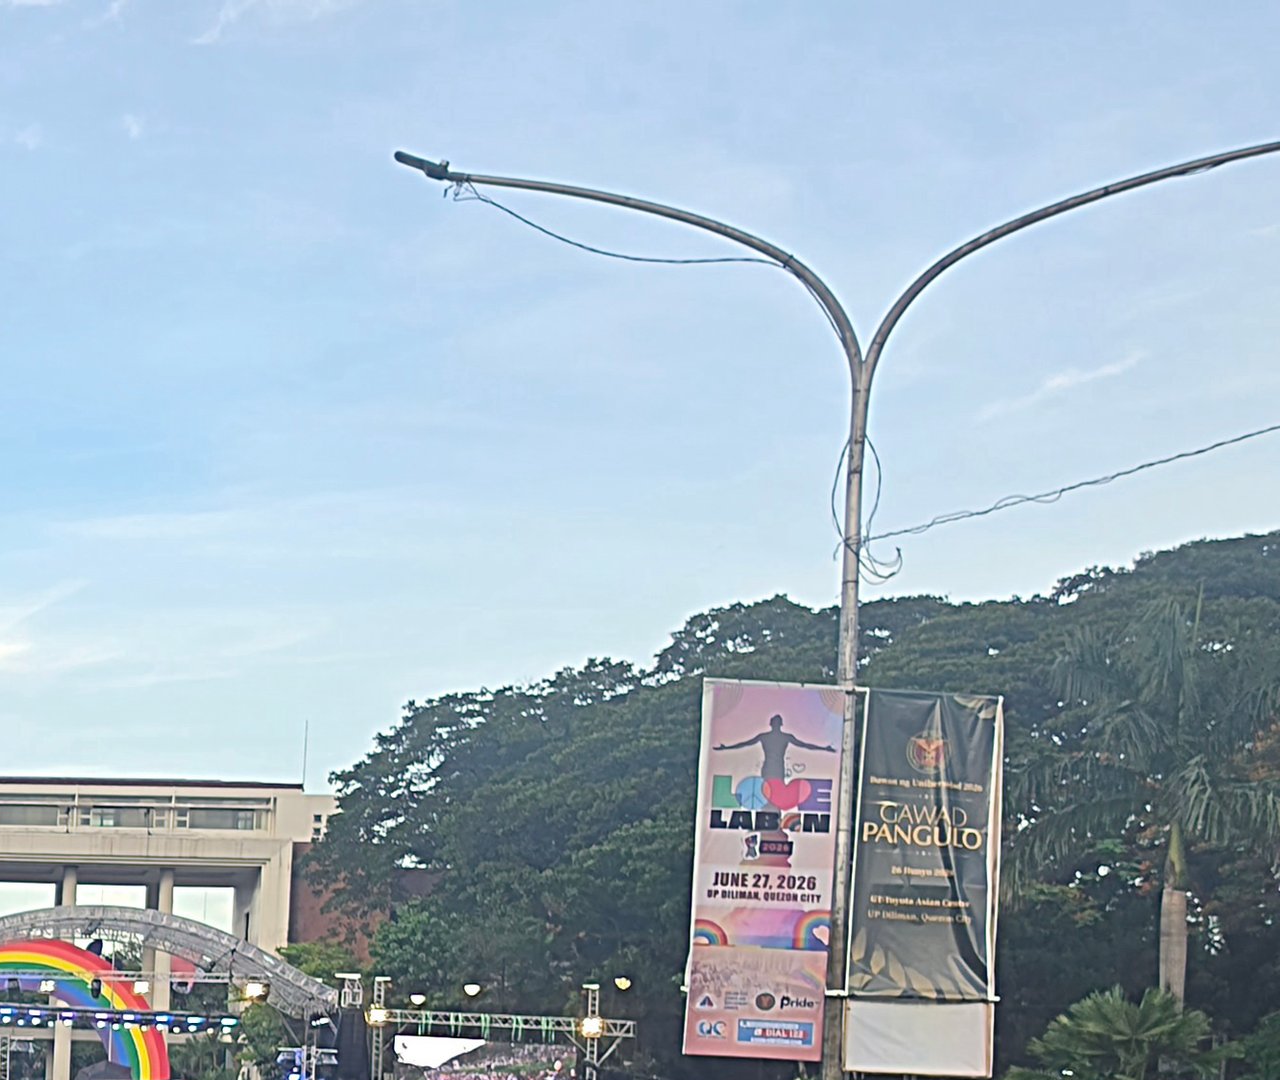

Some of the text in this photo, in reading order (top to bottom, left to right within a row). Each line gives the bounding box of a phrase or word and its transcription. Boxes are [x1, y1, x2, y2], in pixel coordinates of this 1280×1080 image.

[879, 801, 968, 827] GAWAD
[862, 822, 983, 850] PANGULO
[762, 843, 790, 852] 2026
[712, 872, 817, 891] JUNE 27, 2026
[707, 889, 822, 904] UP DILIMAN, QUEZON CITY
